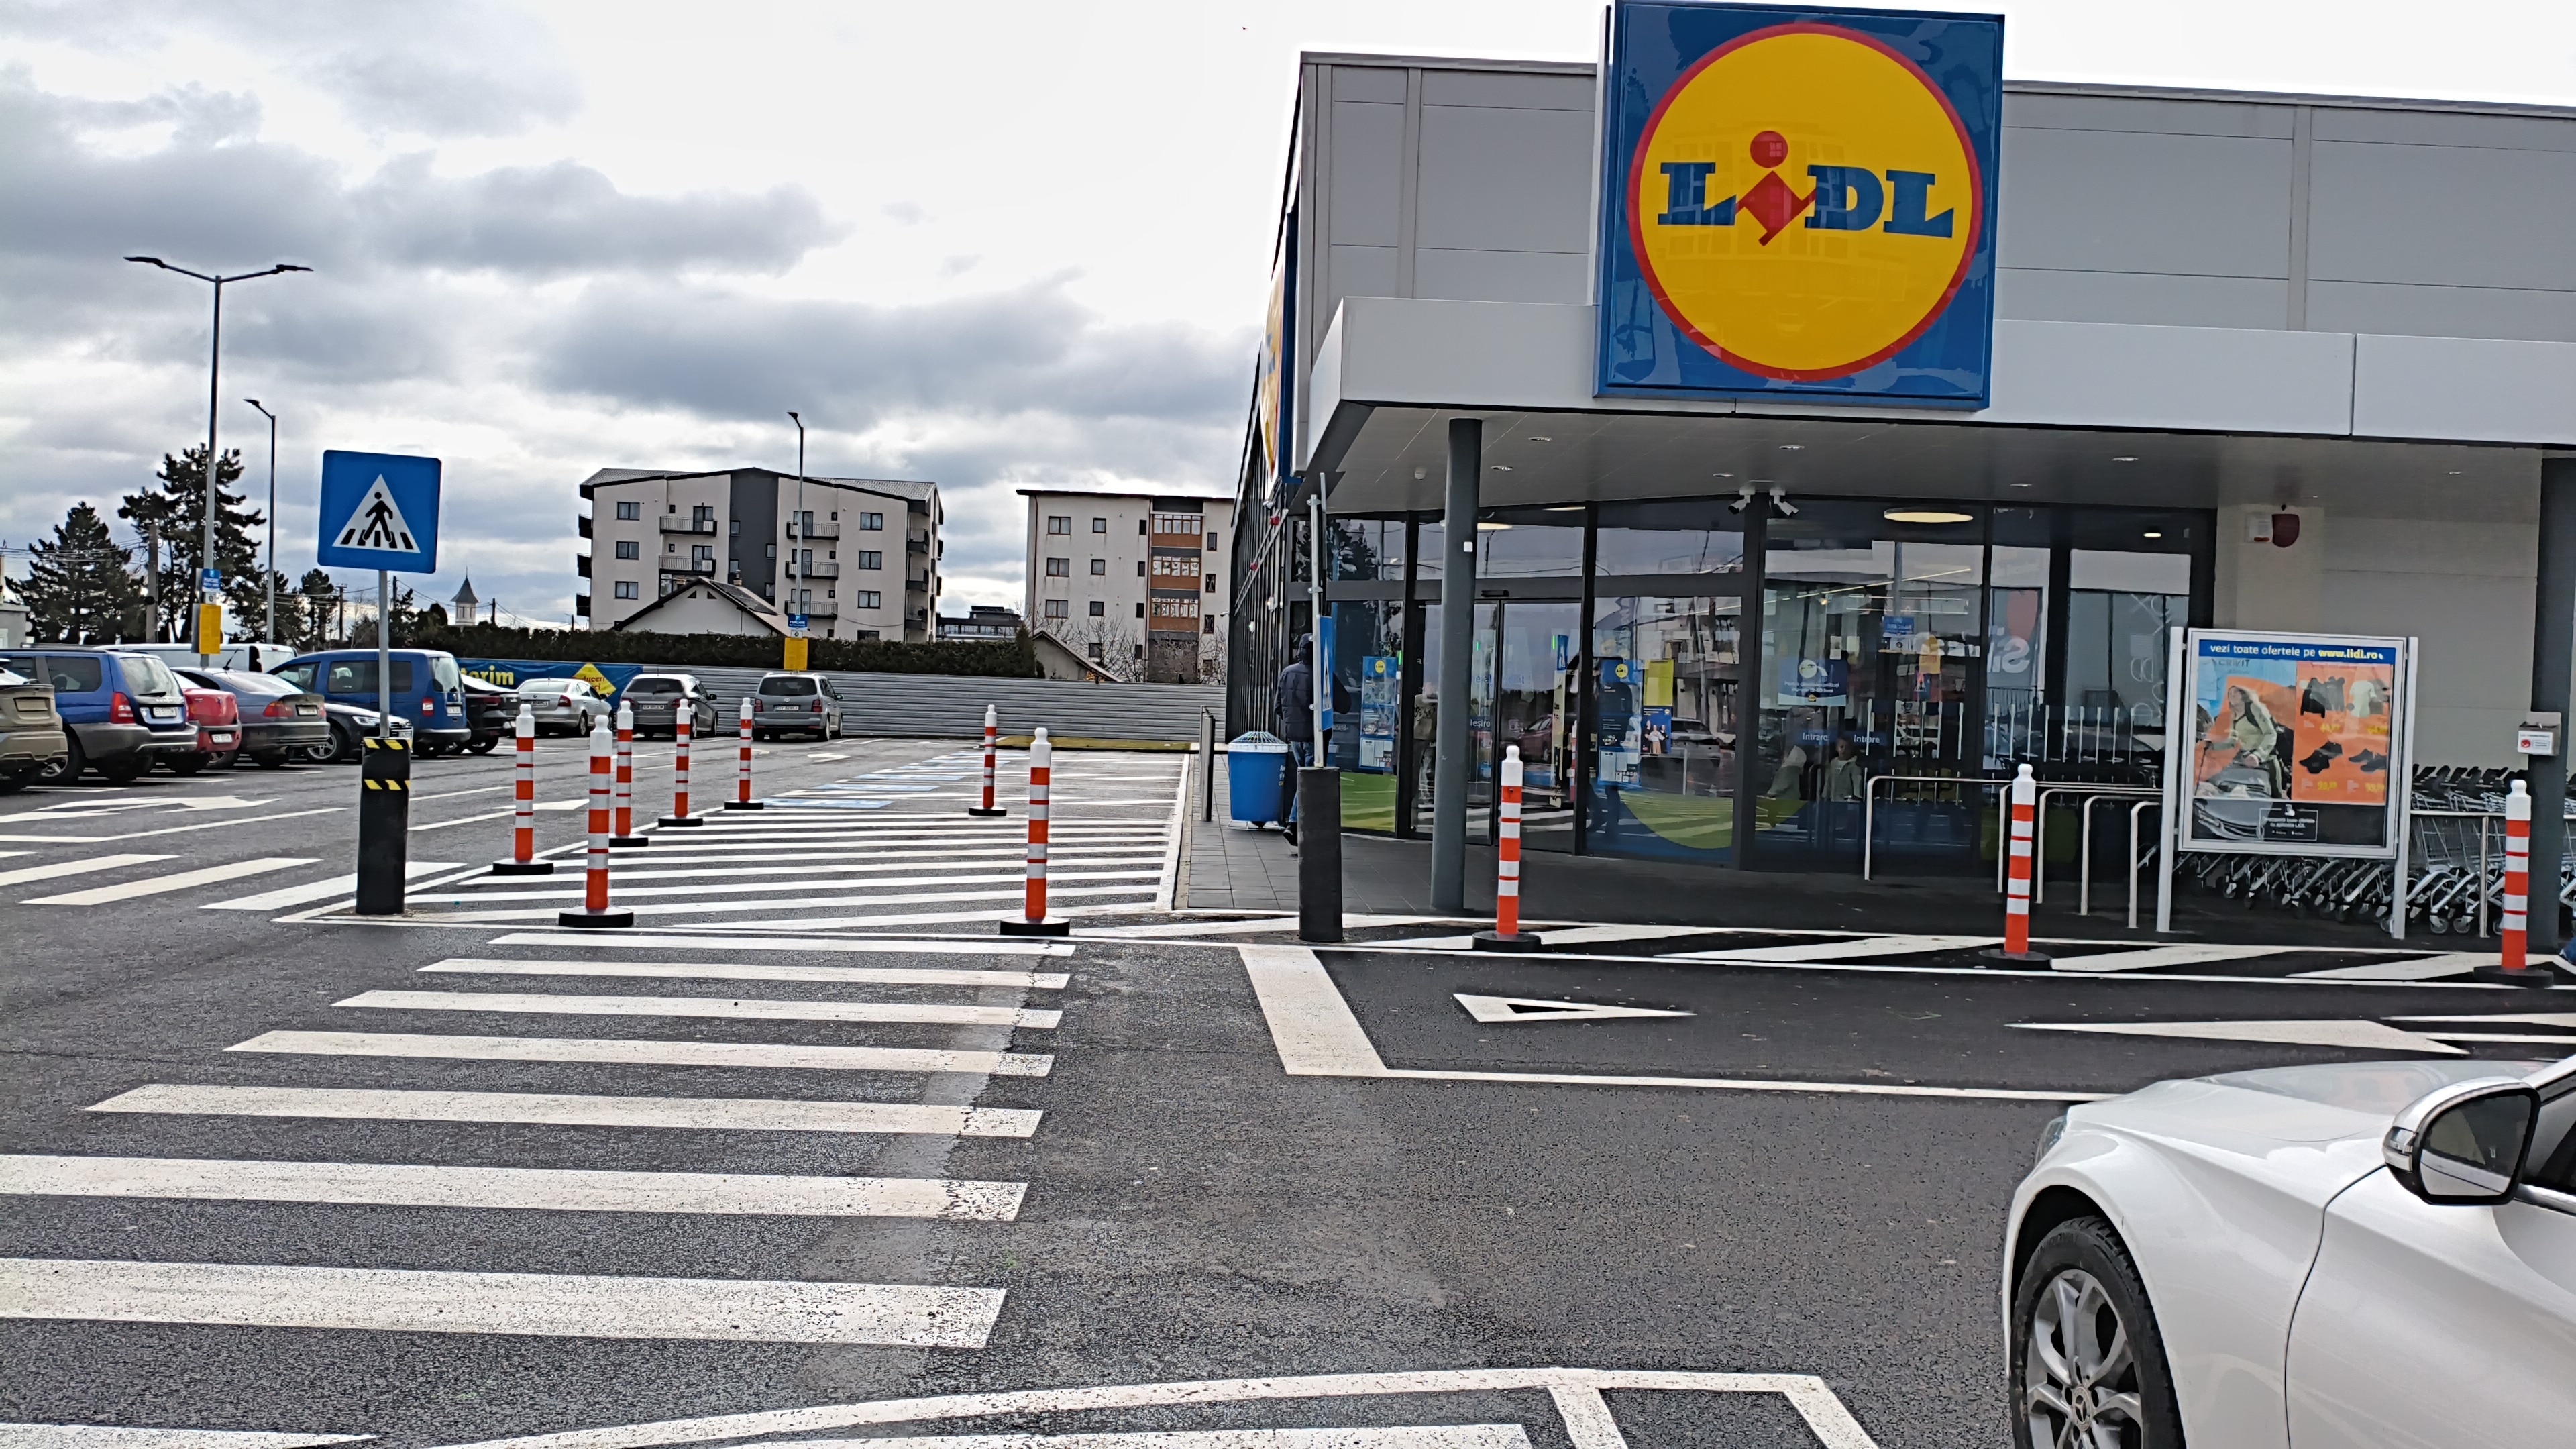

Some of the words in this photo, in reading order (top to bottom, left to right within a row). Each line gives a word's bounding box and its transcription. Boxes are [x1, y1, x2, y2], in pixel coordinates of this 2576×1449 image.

[2210, 644, 2230, 653] vezi
[2233, 645, 2259, 655] toate
[2261, 646, 2300, 657] ofertele
[2304, 649, 2316, 659] pe
[2318, 649, 2378, 660] www.lidl.ro
